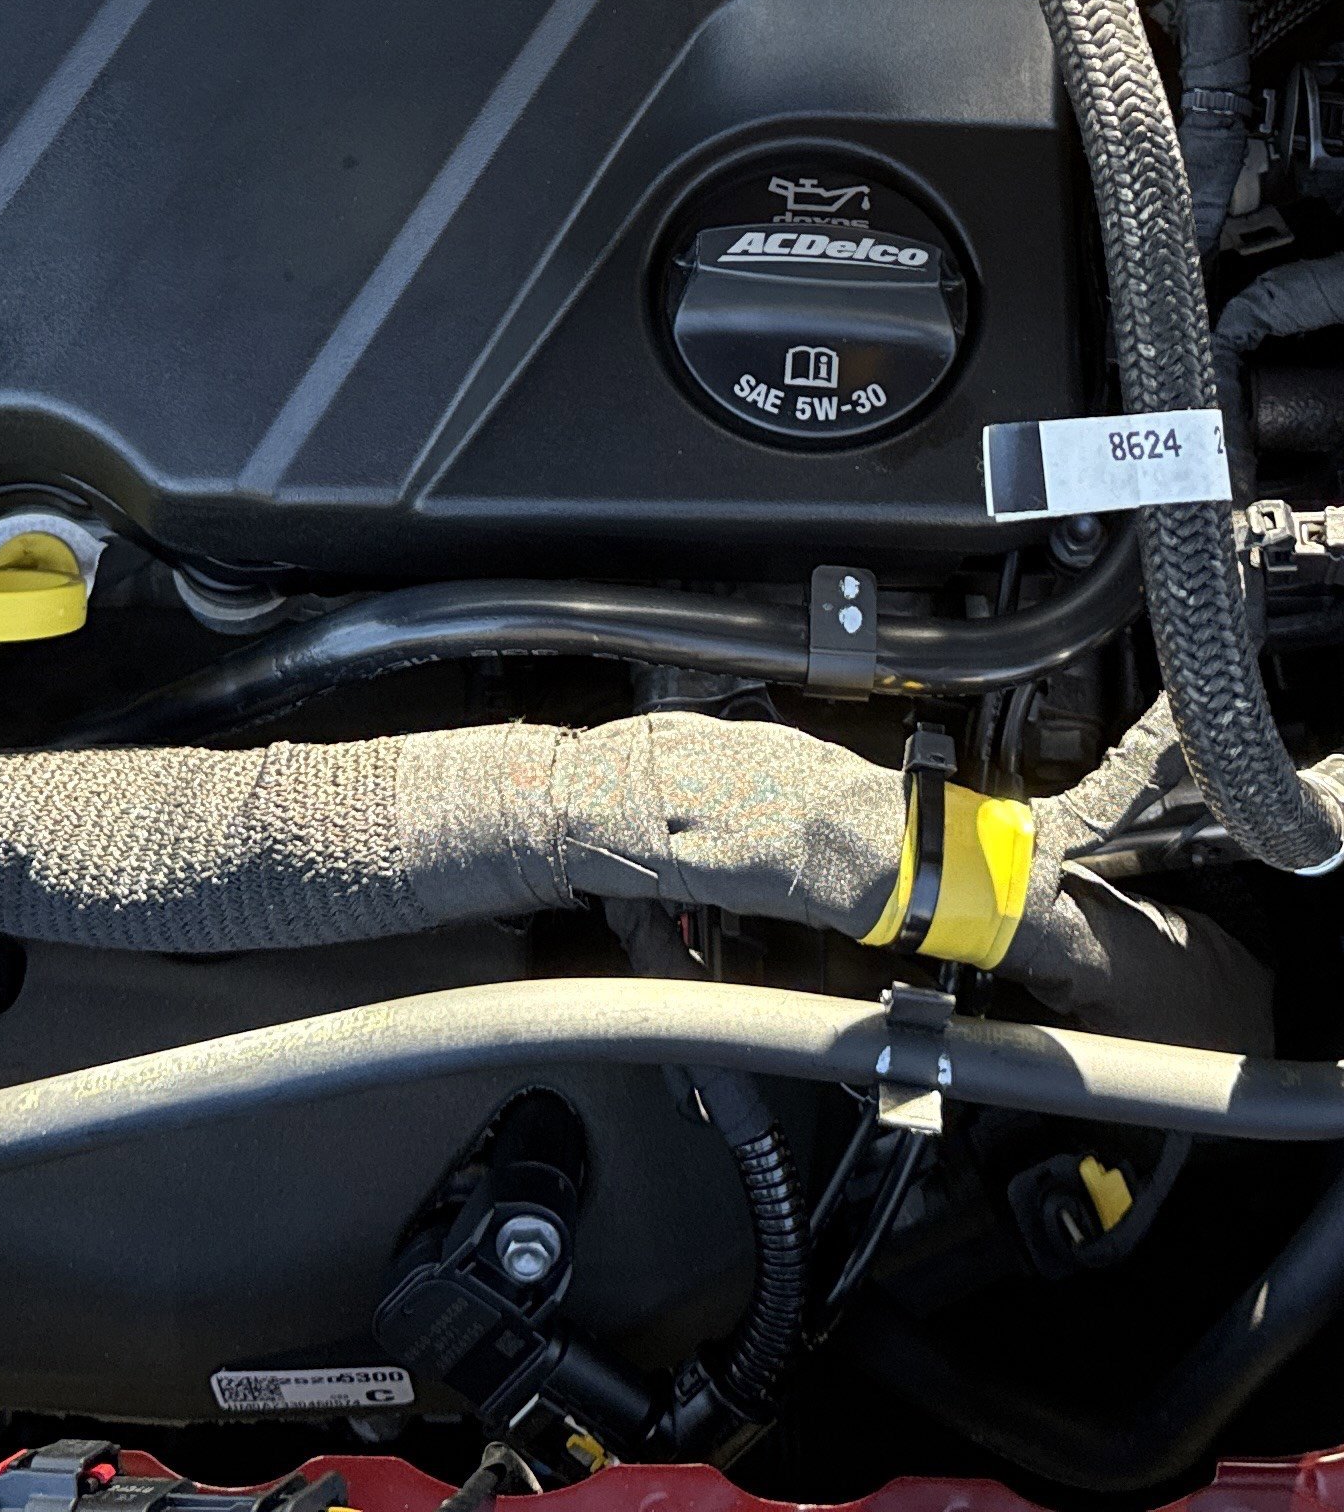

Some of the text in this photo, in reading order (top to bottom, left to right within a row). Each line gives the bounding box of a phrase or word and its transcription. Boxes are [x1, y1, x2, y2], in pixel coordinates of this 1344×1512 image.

[727, 232, 929, 266] ACDelco
[733, 374, 887, 421] SAE 5W-30
[1109, 428, 1182, 461] 8624
